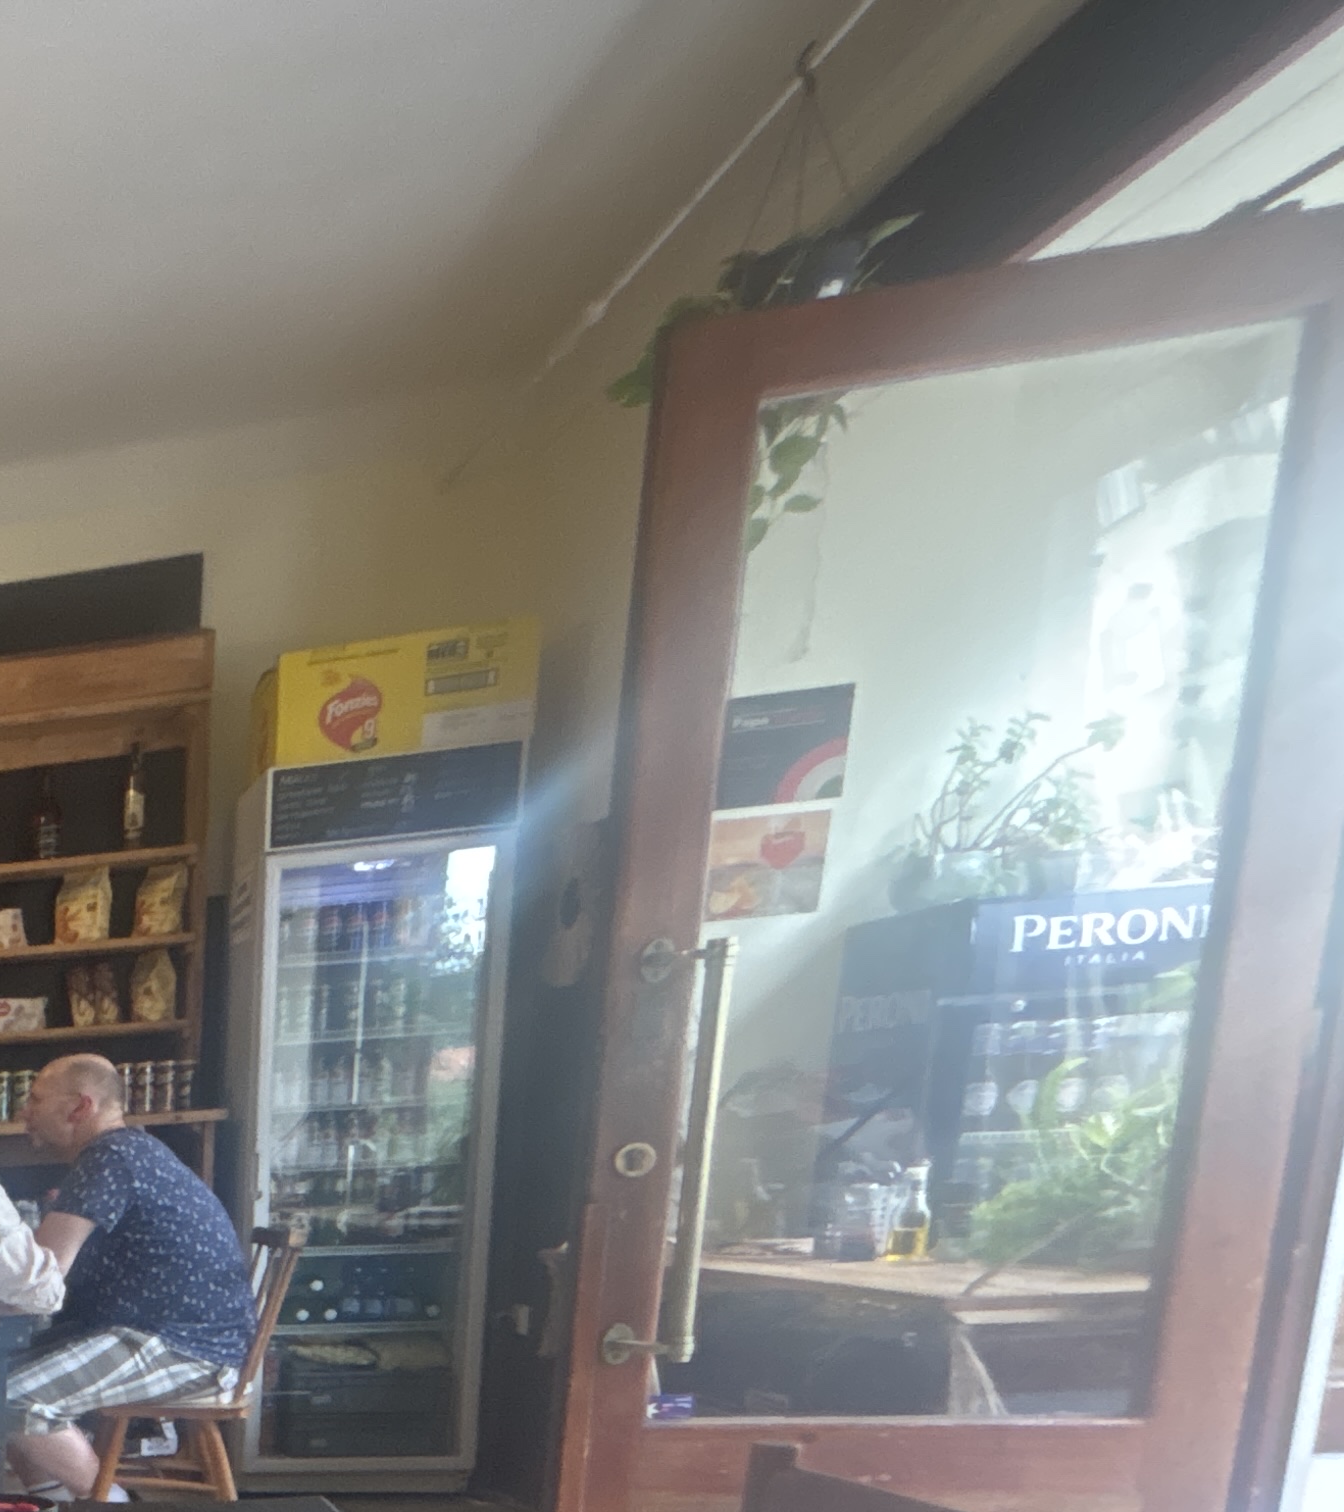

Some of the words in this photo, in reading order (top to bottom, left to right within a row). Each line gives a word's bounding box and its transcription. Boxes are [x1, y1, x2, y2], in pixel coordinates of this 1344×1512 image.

[325, 693, 379, 725] Fonzies
[1009, 903, 1211, 953] PERONI
[1063, 950, 1146, 967] ITALIA
